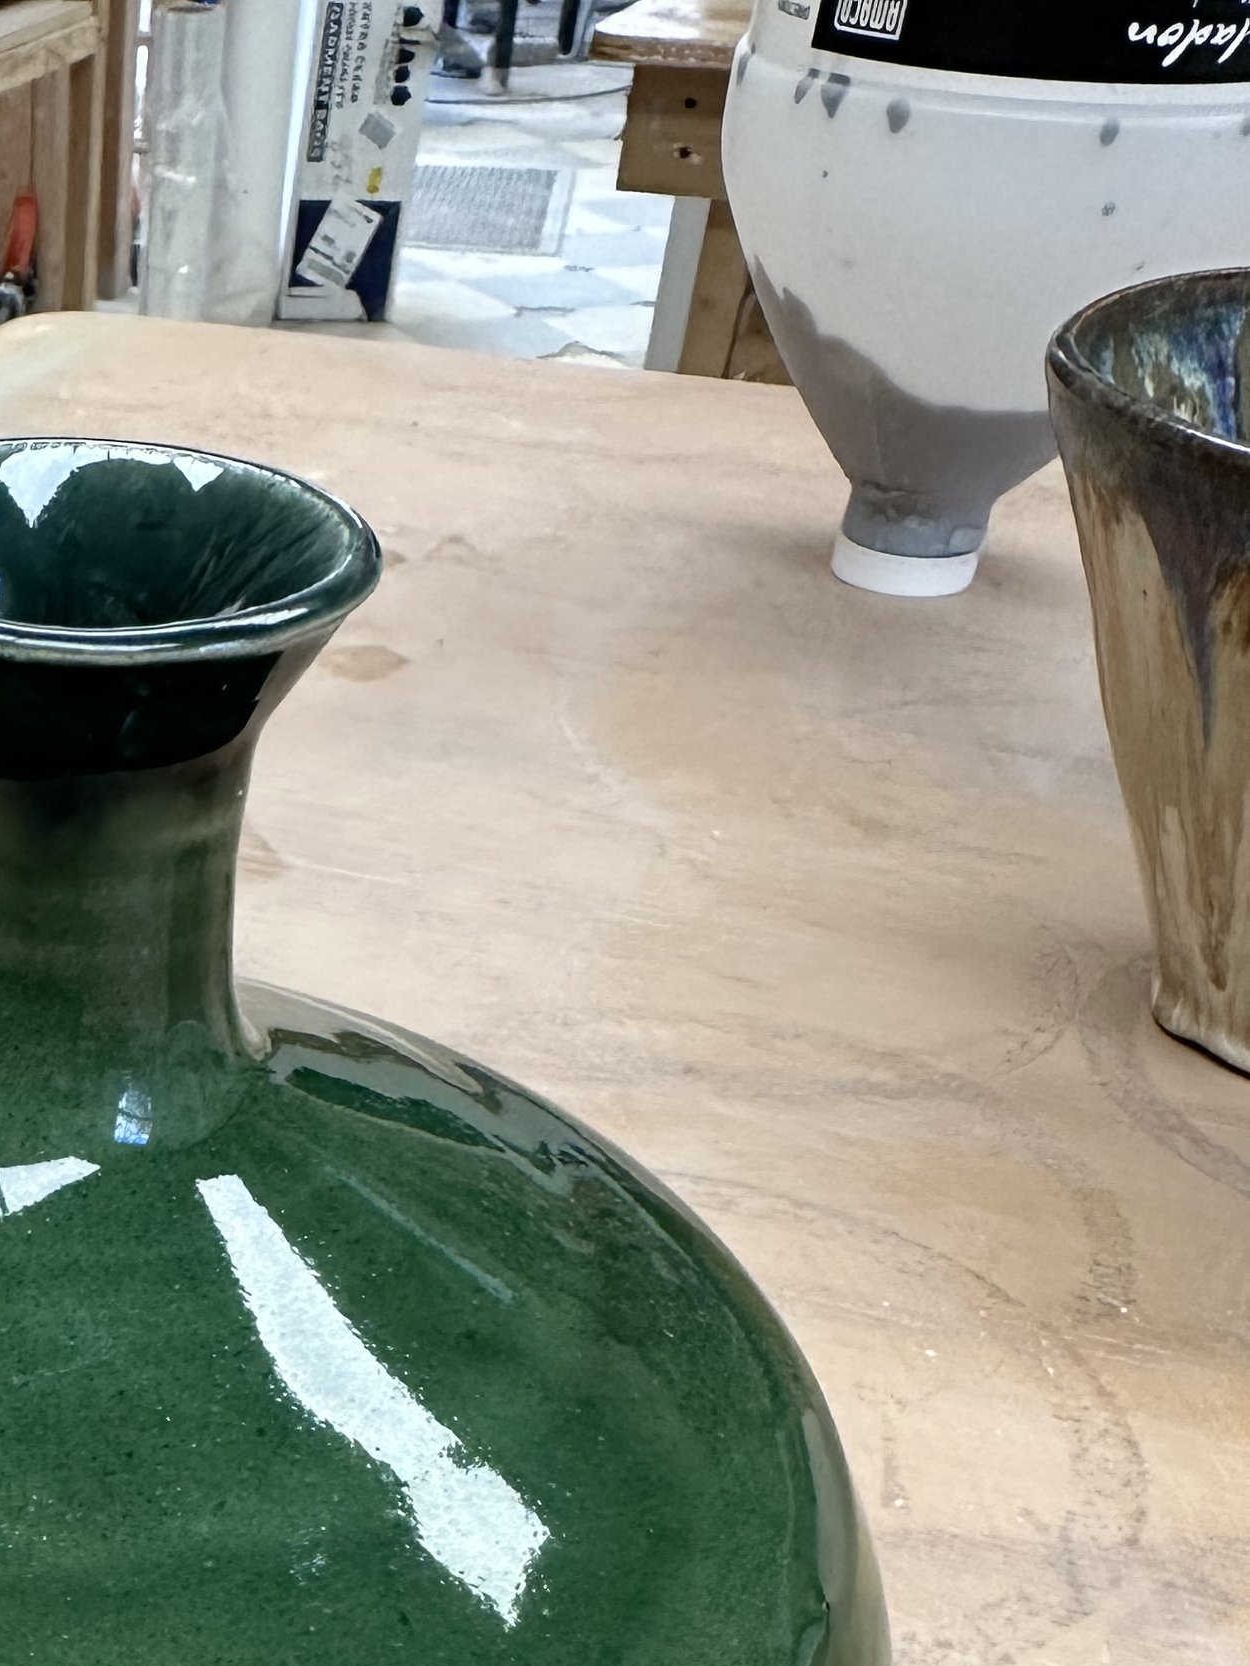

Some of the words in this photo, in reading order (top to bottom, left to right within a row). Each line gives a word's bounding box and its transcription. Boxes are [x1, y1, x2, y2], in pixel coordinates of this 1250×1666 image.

[840, 0, 900, 31] AMACO
[316, 4, 342, 105] GARMENT
[1128, 17, 1250, 68] ladon
